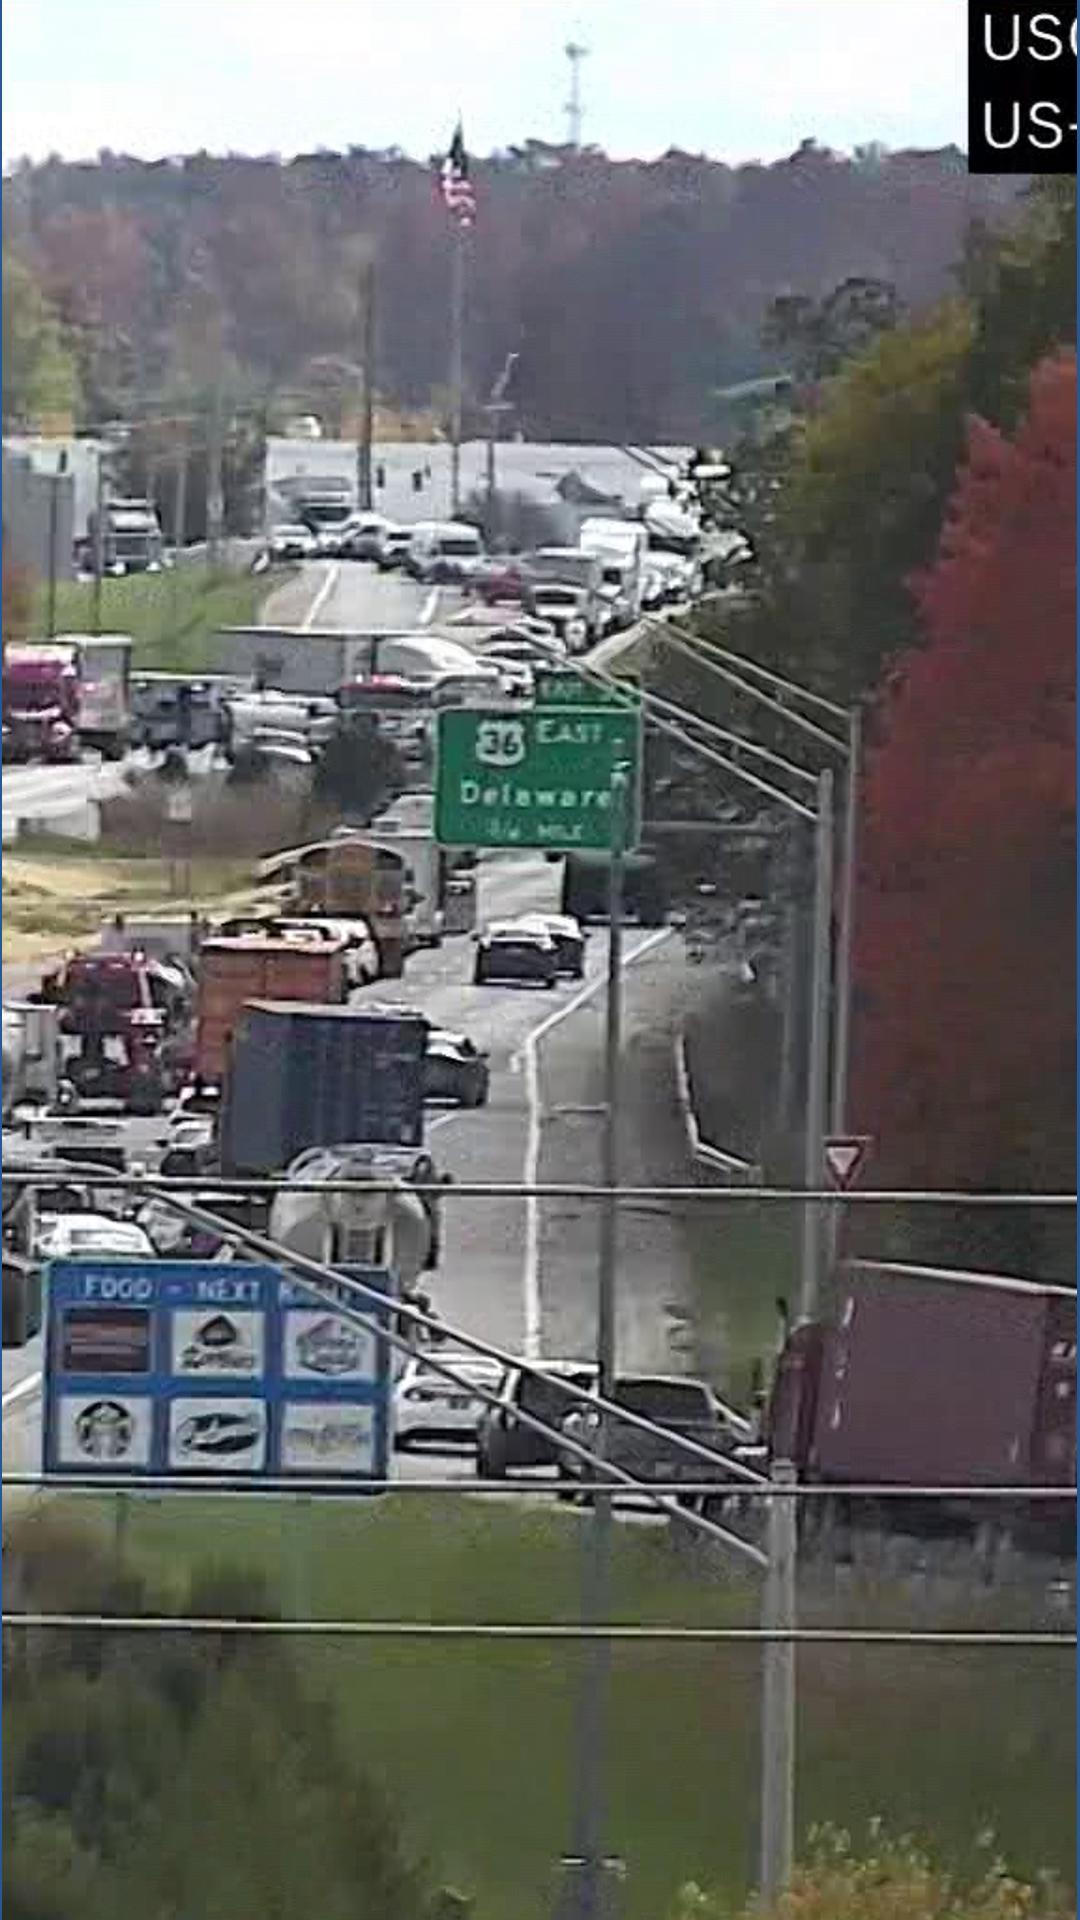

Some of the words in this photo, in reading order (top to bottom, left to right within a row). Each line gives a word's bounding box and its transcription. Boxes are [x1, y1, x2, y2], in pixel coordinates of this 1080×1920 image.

[483, 729, 518, 755] 36
[536, 721, 602, 744] EAST
[460, 778, 611, 808] Delaware
[536, 823, 583, 841] MILE
[84, 1274, 153, 1299] FOOD
[198, 1279, 262, 1301] NEXT
